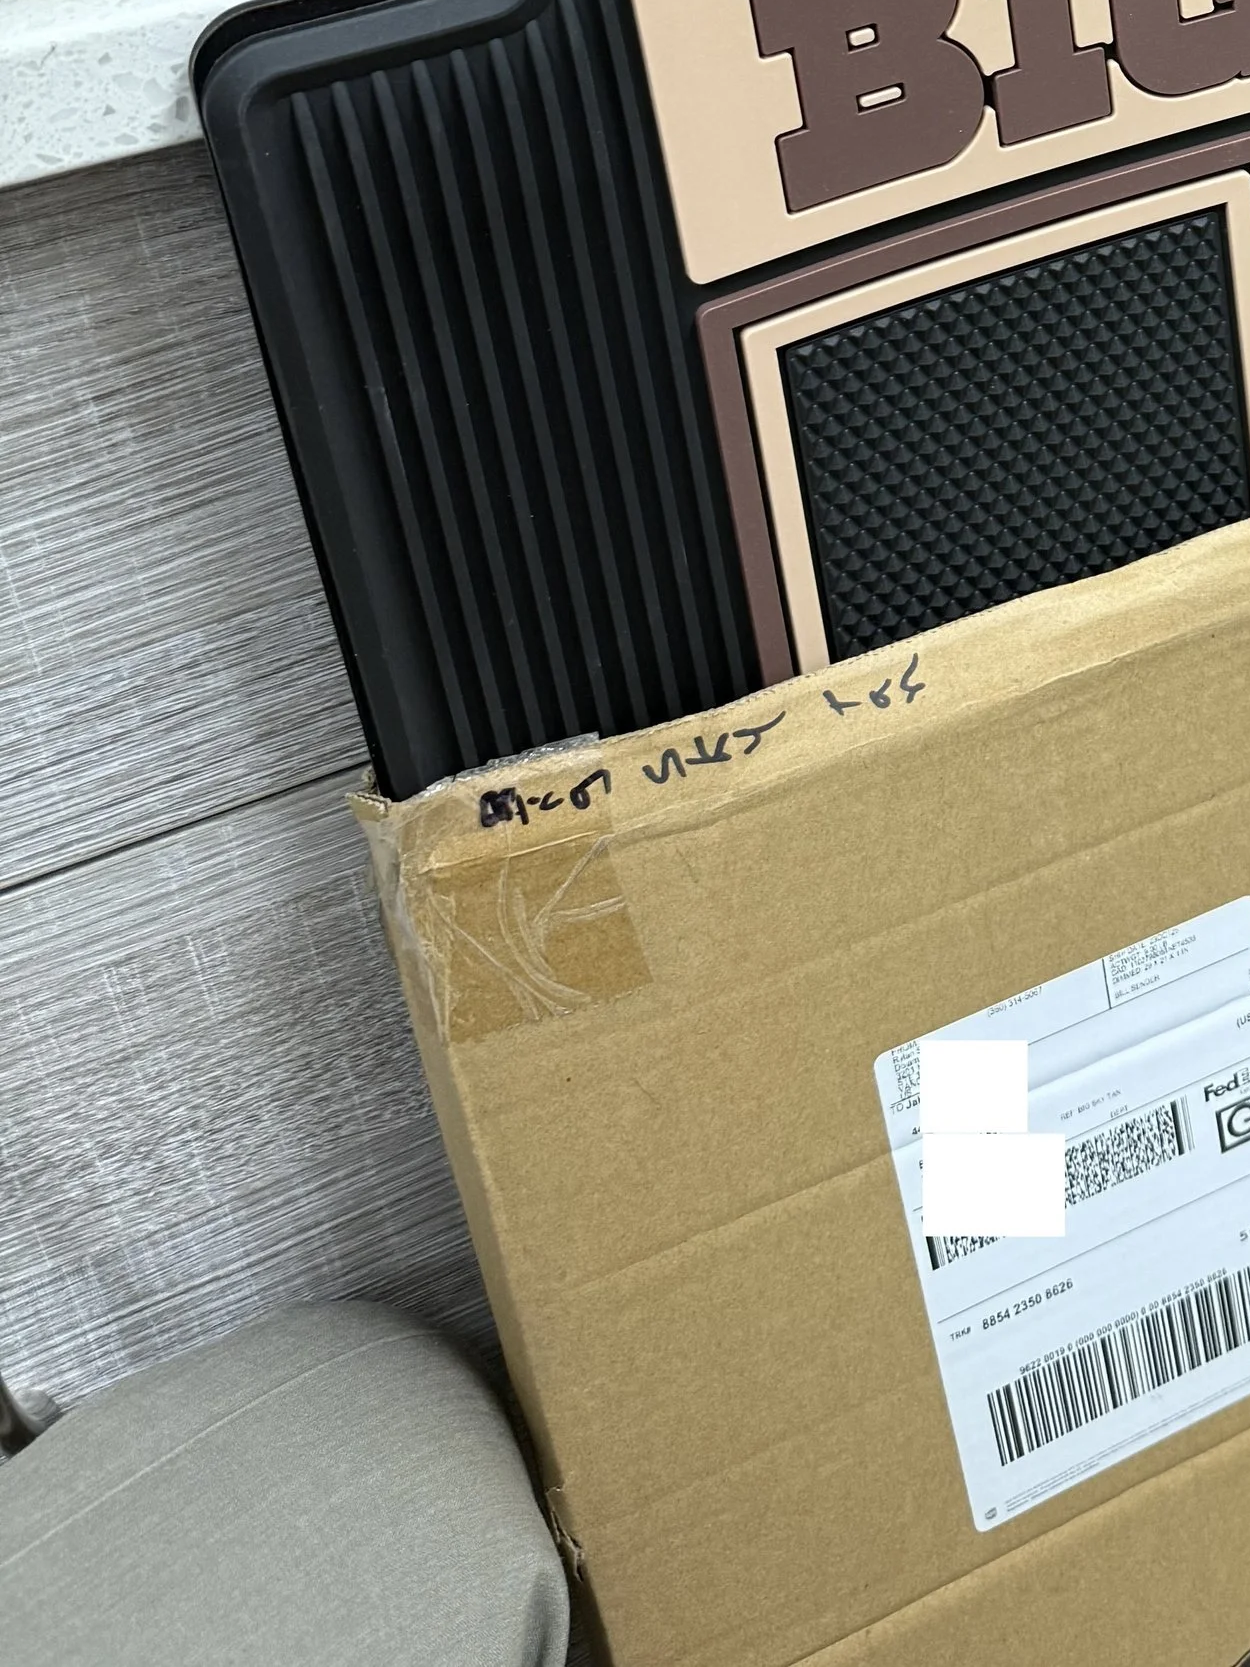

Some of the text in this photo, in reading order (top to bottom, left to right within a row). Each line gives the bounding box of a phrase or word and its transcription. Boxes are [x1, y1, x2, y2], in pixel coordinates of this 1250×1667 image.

[982, 1308, 1011, 1330] 8854
[1013, 1293, 1042, 1316] 2350
[1045, 1278, 1073, 1300] 8626
[1019, 1357, 1041, 1375] 9622
